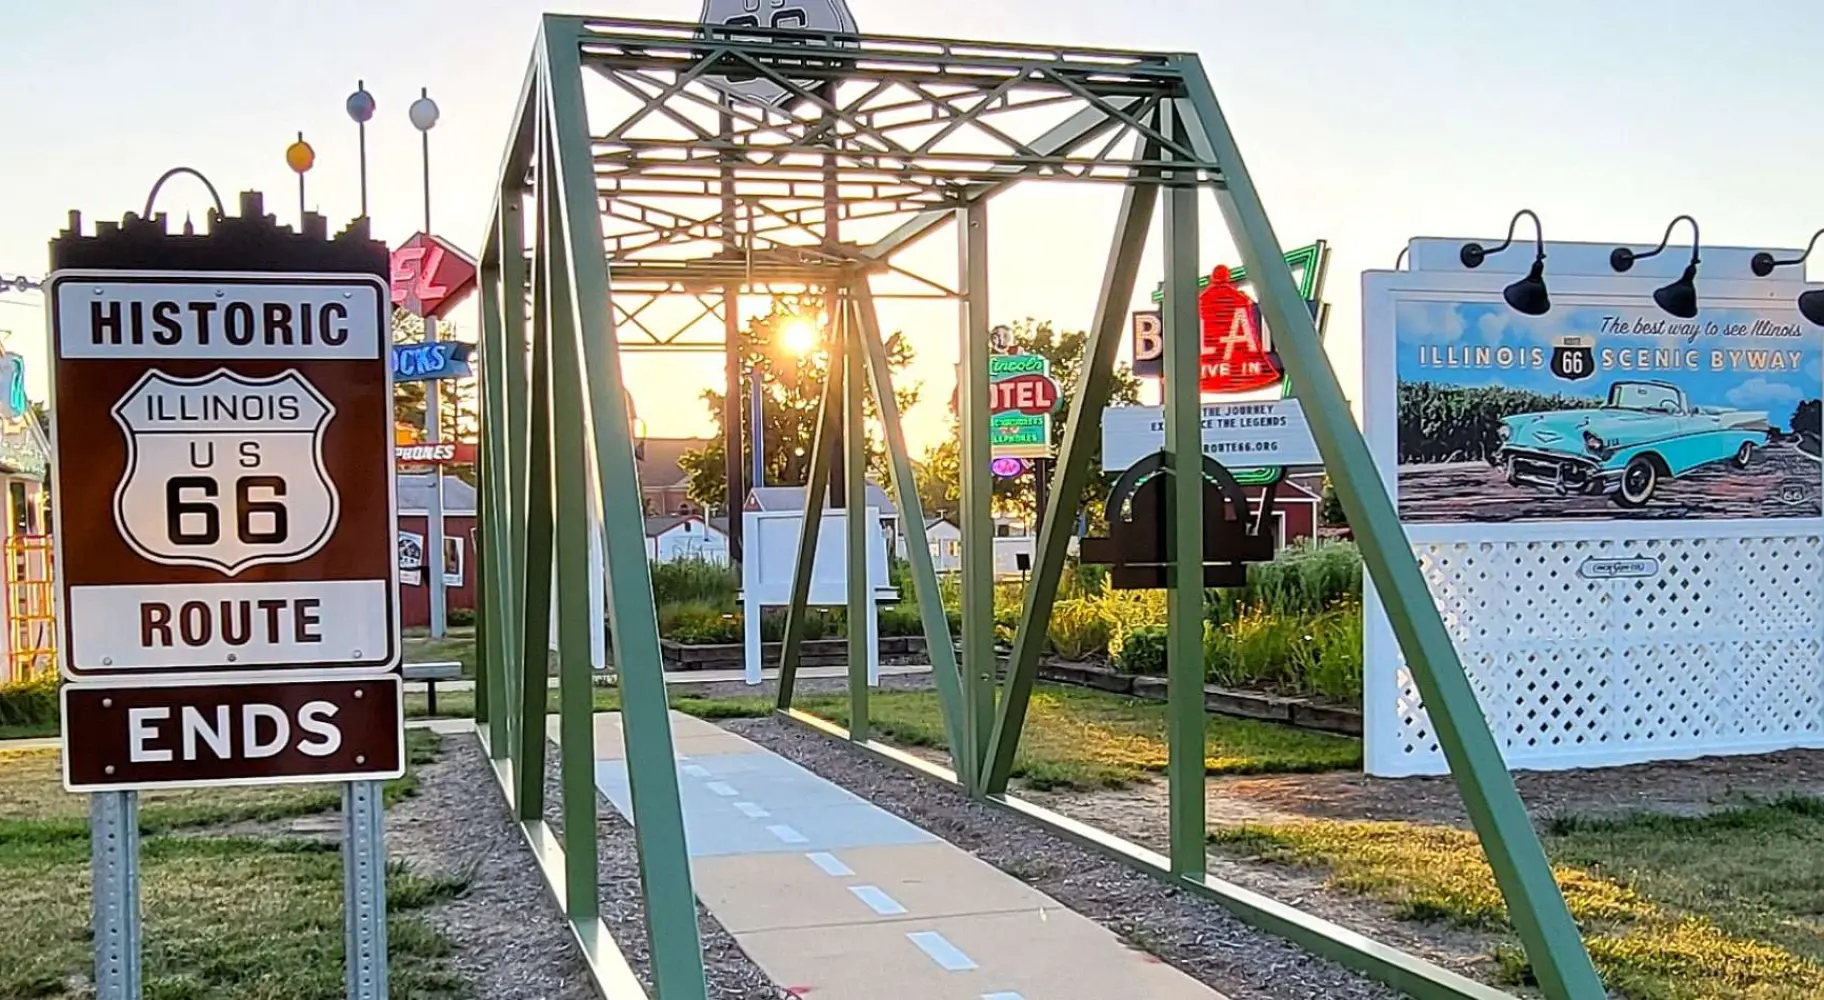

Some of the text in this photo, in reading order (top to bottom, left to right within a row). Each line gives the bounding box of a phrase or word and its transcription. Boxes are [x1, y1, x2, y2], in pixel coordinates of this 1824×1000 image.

[91, 300, 348, 346] HISTORIC
[1601, 316, 1802, 343] The best way to see Illinois
[1242, 361, 1261, 373] IN
[1420, 346, 1544, 370] ILLINOIS
[1562, 351, 1583, 374] 66
[1602, 348, 1803, 371] SCENIC BYWAY
[147, 395, 300, 420] ILLINOIS
[1203, 404, 1274, 417] THE JOURNEY
[1218, 418, 1236, 429] THE
[1241, 416, 1287, 428] LEGENDS
[1203, 441, 1278, 453] ROUTE66.ORG
[167, 475, 288, 545] 66
[140, 598, 322, 647] ROUTE
[128, 701, 342, 762] ENDS
